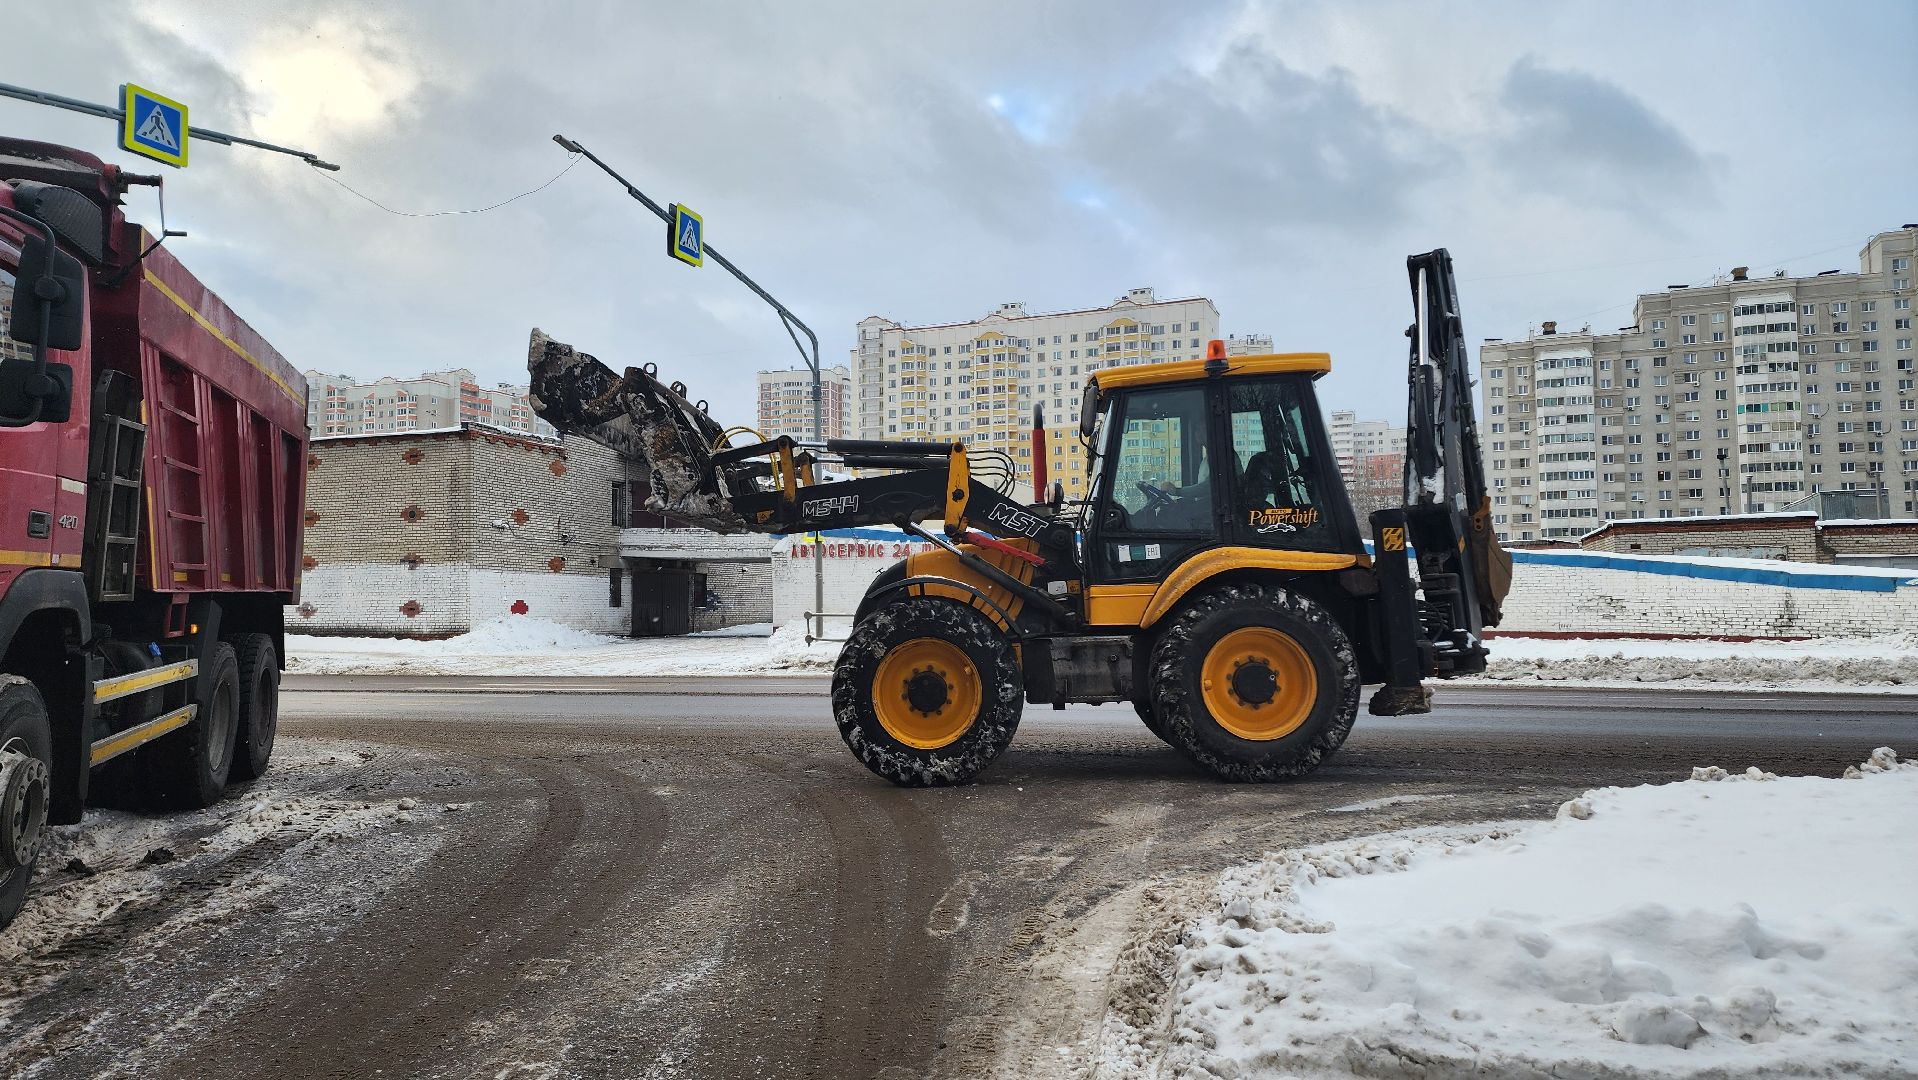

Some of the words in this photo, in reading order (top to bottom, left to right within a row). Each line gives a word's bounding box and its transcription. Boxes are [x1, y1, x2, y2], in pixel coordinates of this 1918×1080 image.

[59, 514, 79, 529] 420
[988, 502, 1049, 537] MST
[1248, 507, 1319, 529] Powershift
[893, 543, 911, 558] 24
